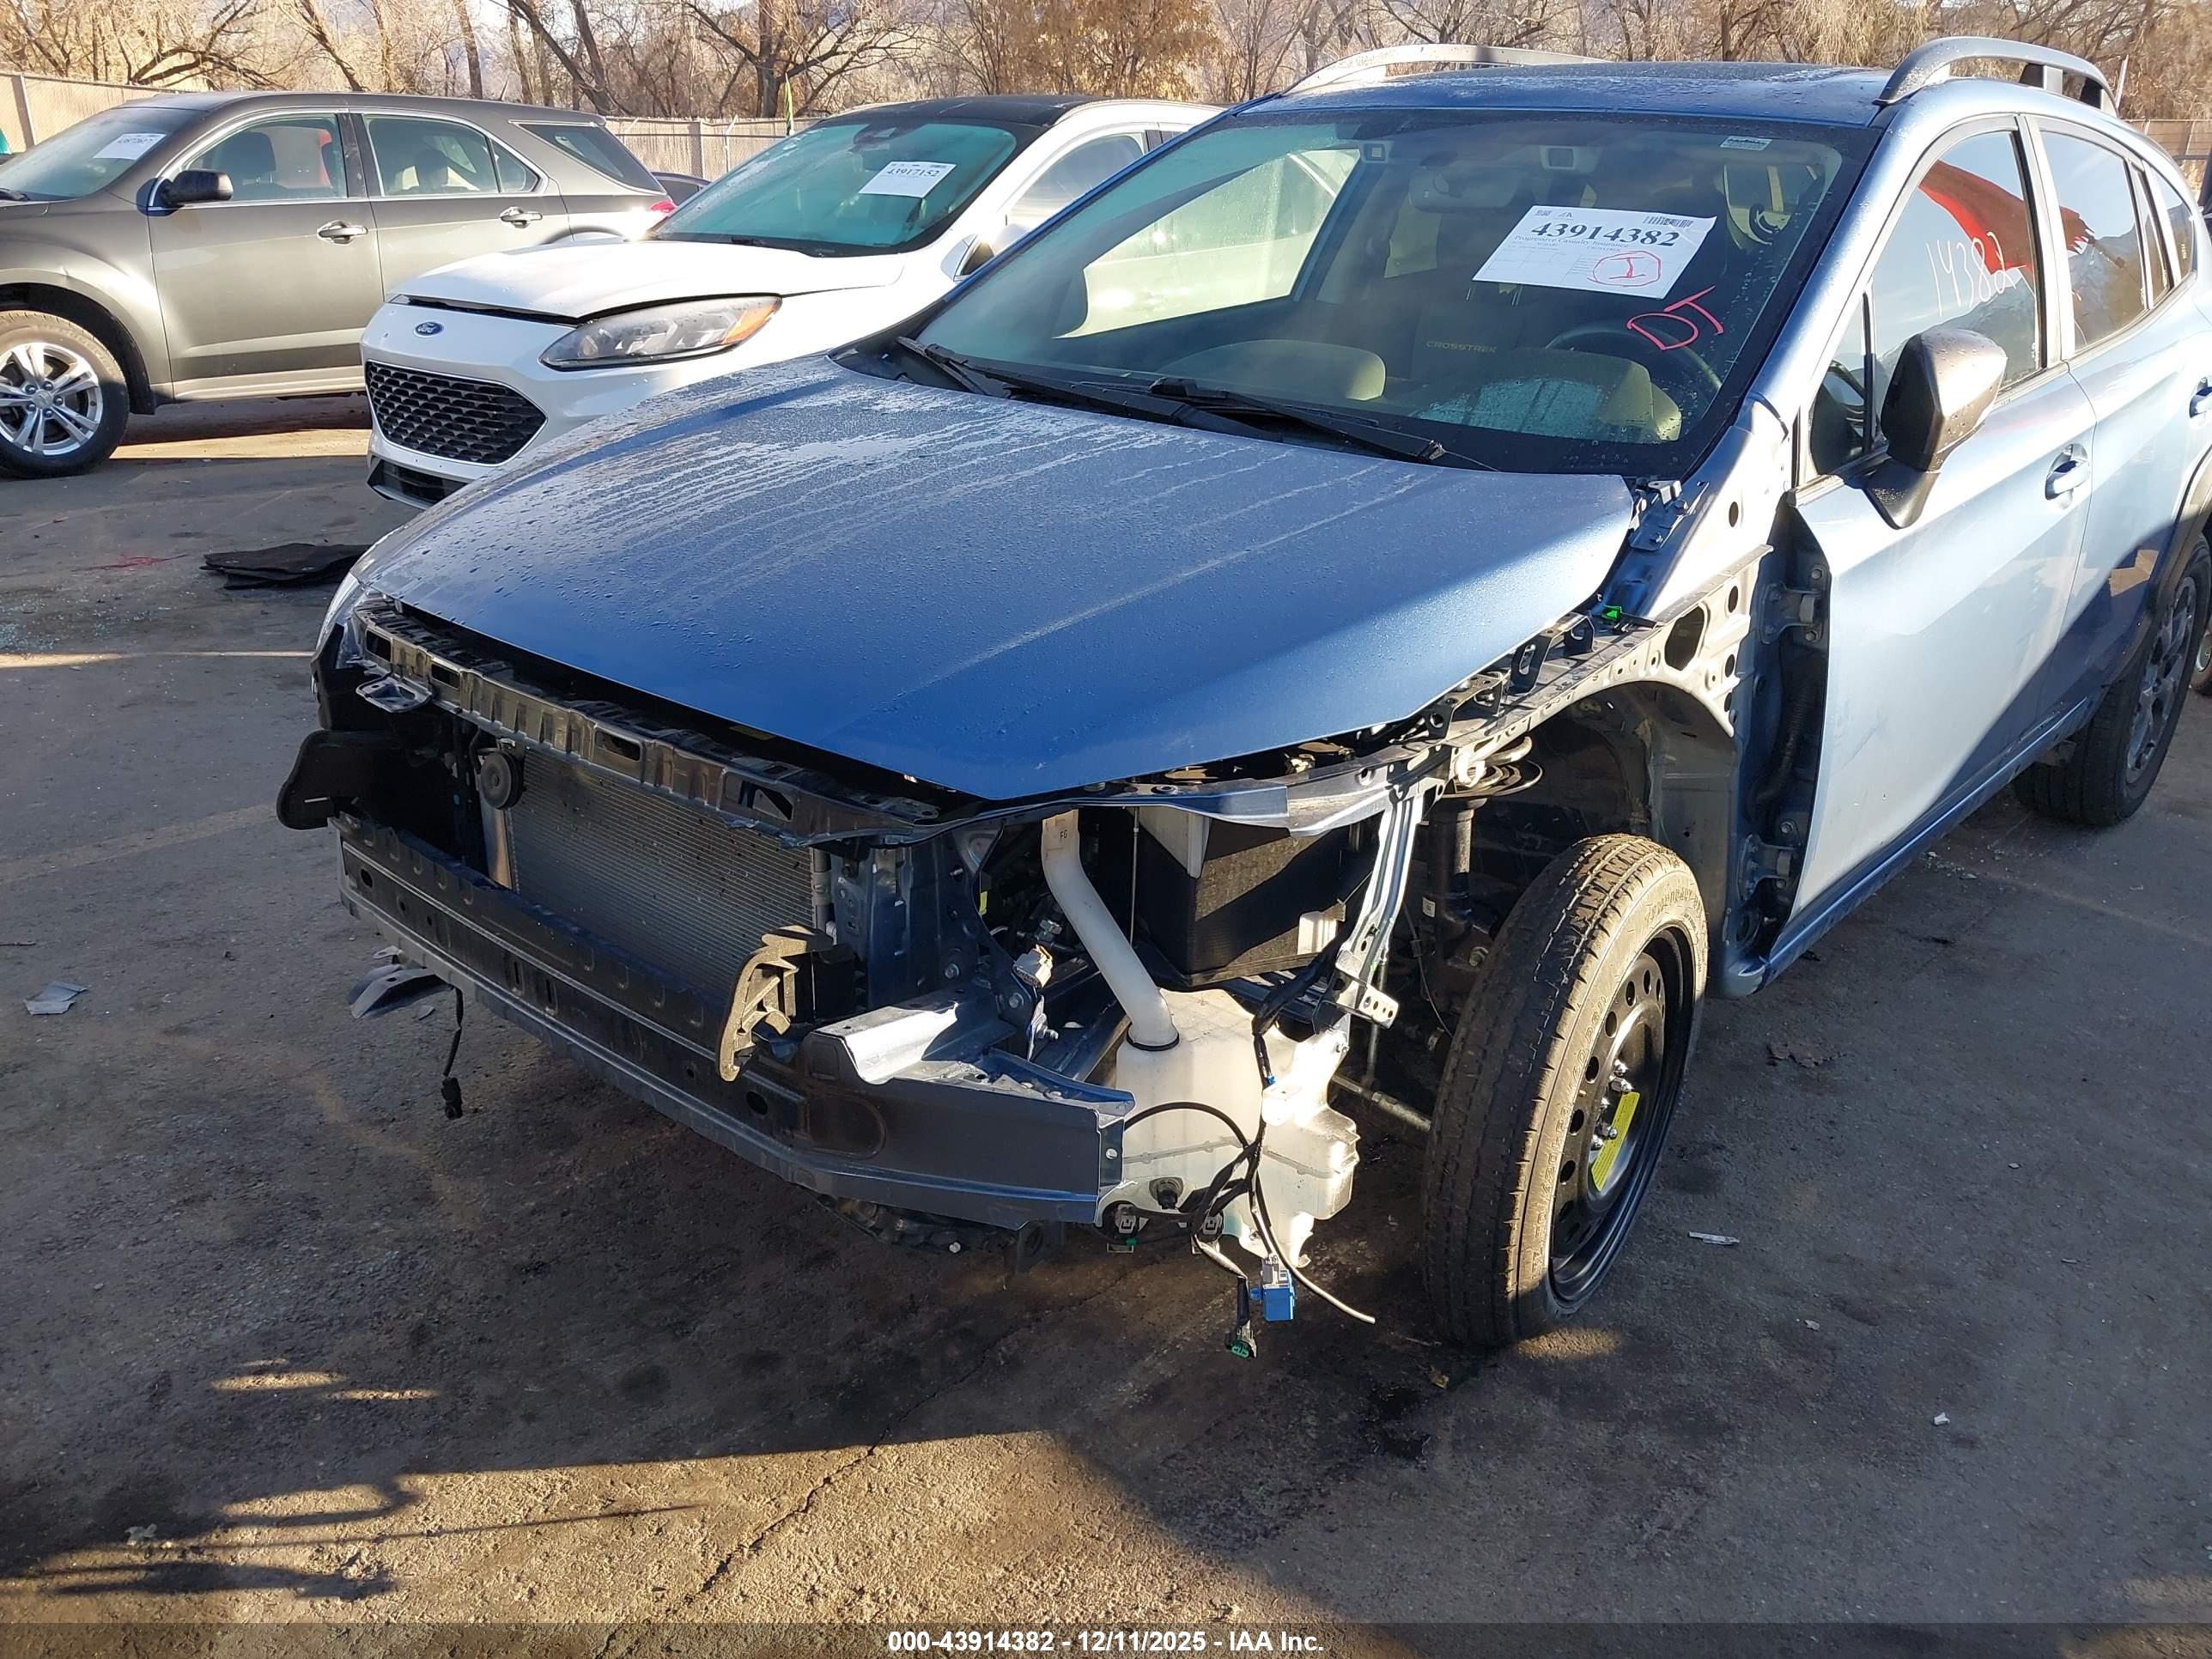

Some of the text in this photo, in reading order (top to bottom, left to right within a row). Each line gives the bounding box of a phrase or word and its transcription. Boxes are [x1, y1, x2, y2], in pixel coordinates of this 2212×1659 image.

[887, 168, 940, 177] 43917152
[1514, 234, 1557, 244] Progressive
[1531, 222, 1680, 247] 43914382
[1925, 231, 2017, 317] 14382
[1425, 341, 1498, 353] CROSSTREK
